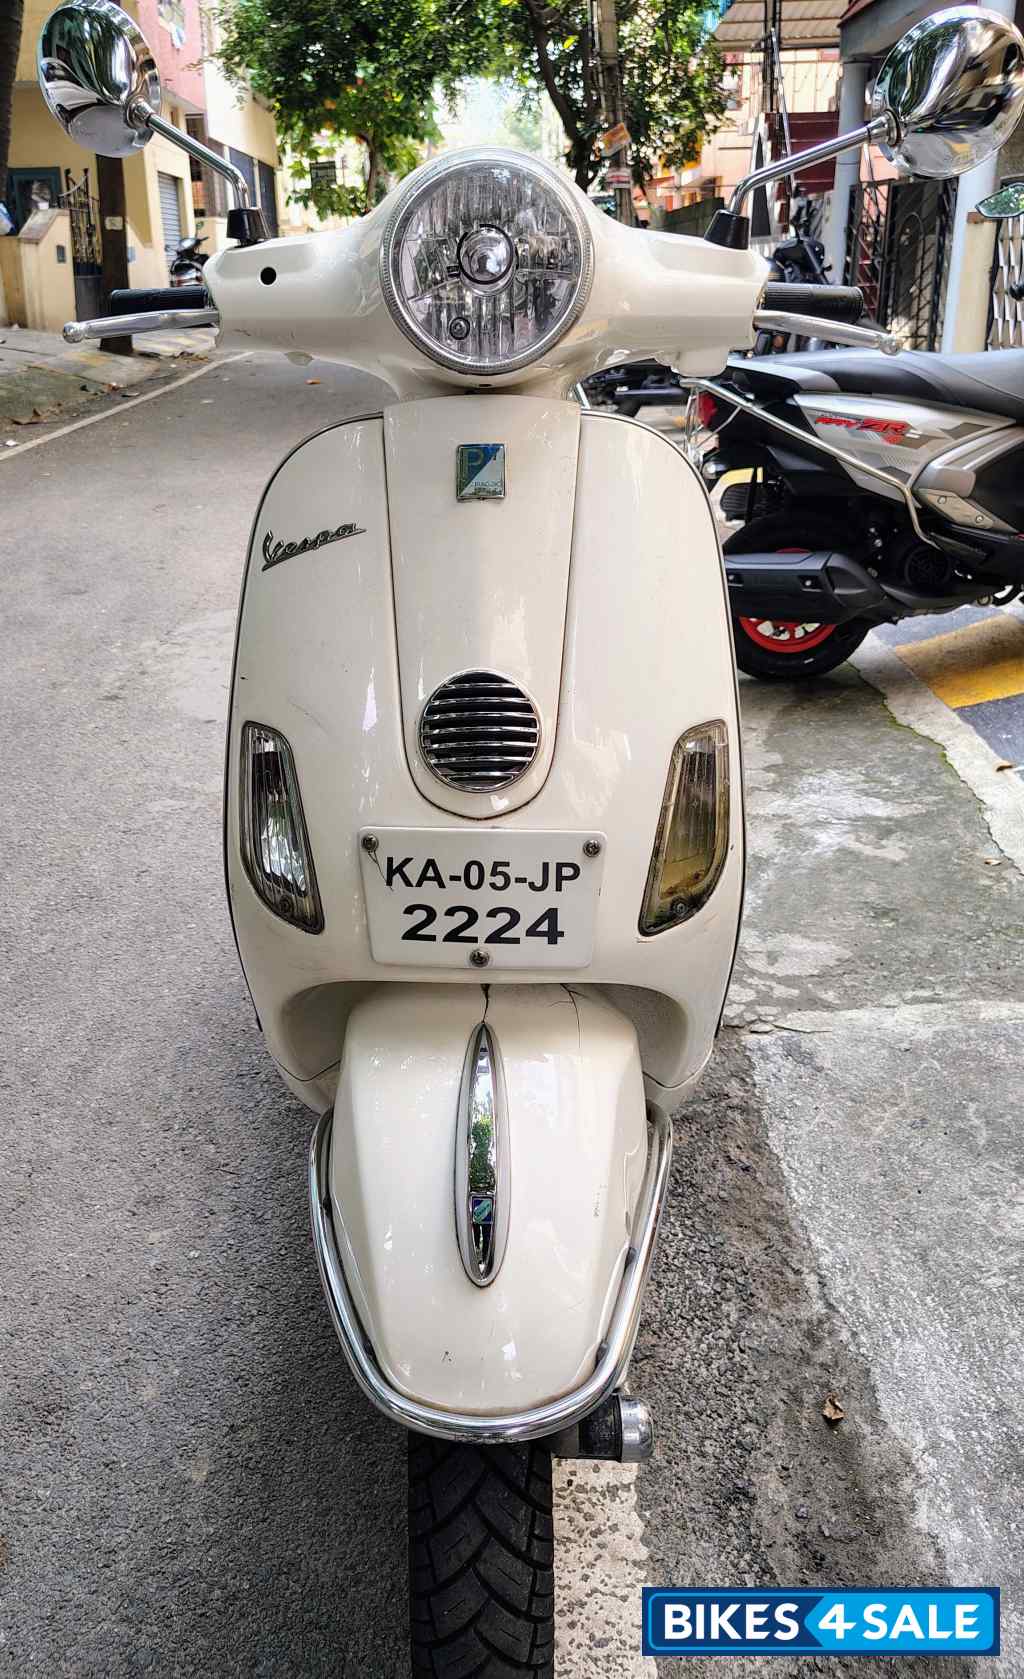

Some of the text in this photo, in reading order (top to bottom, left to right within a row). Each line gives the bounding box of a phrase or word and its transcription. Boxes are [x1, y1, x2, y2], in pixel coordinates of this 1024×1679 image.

[262, 523, 366, 571] Vespa
[386, 856, 581, 892] KA-05-JP
[401, 903, 565, 945] 2224
